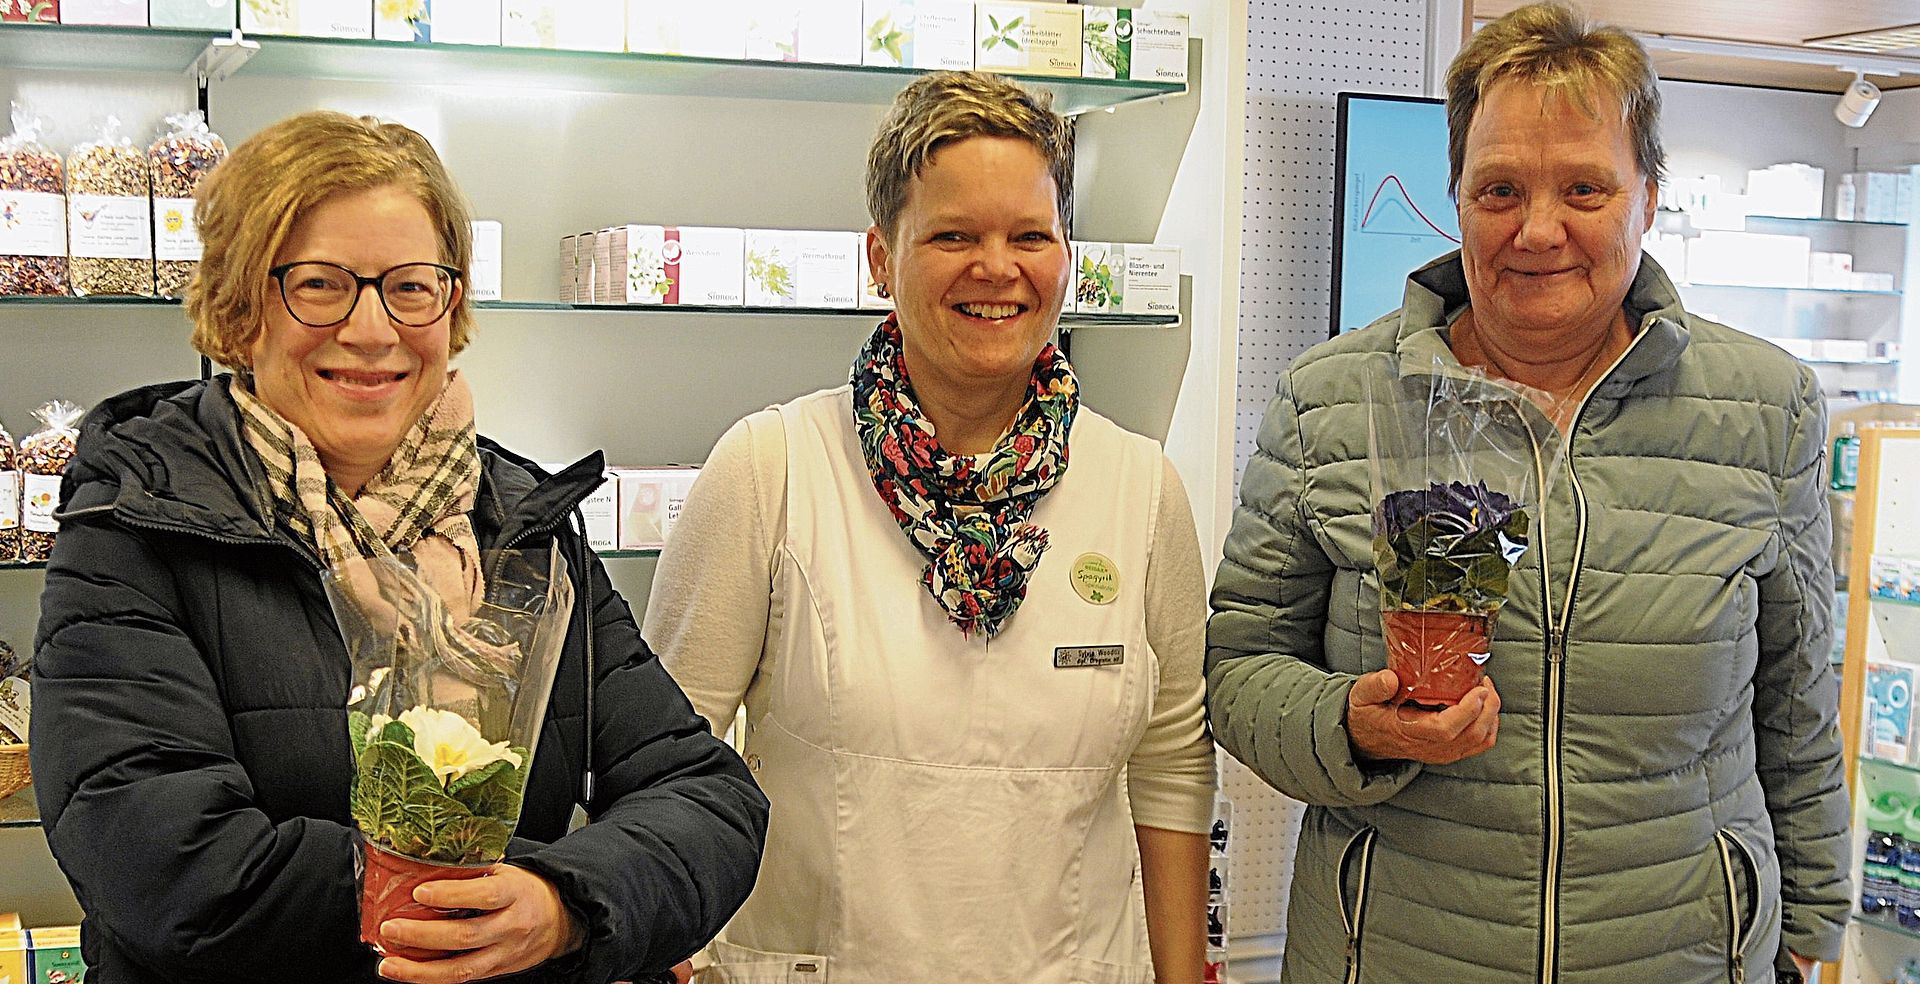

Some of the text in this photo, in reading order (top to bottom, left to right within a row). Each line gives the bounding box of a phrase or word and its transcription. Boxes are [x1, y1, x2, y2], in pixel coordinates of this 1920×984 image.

[1136, 27, 1181, 36] Schachtelhalm
[1129, 261, 1152, 269] Blasen-
[1129, 269, 1158, 277] Nierentee
